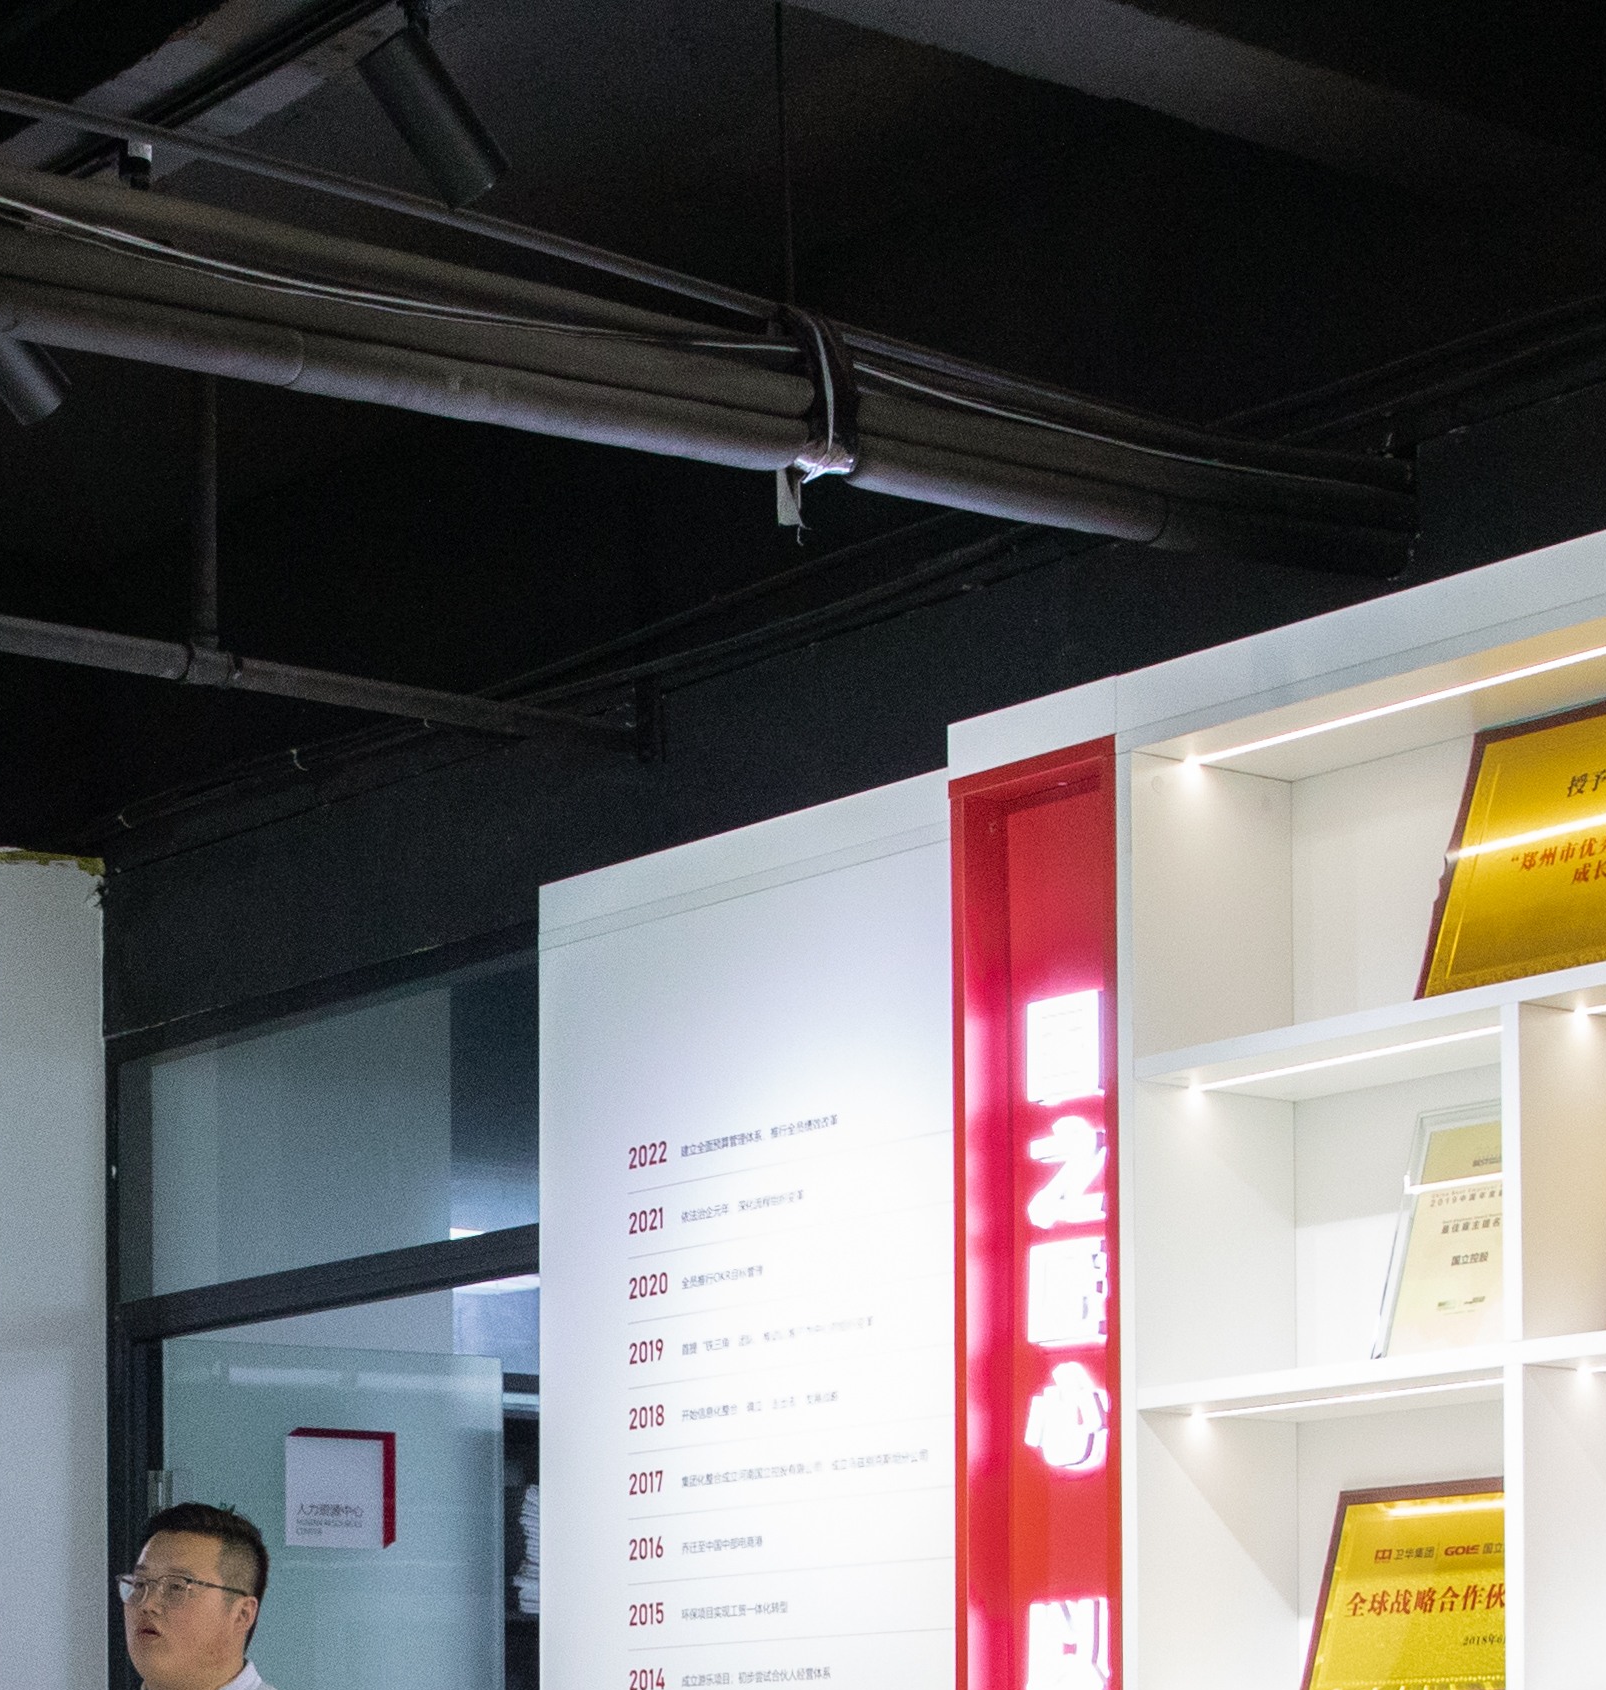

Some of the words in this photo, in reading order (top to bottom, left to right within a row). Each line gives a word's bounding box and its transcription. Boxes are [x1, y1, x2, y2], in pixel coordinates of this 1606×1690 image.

[628, 1140, 668, 1170] 2022
[628, 1206, 665, 1235] 2021
[1450, 1251, 1489, 1266] 国立控股
[628, 1272, 669, 1300] 2020
[628, 1338, 664, 1365] 2019
[628, 1404, 665, 1431] 2018
[628, 1470, 664, 1496] 2017
[628, 1536, 664, 1561] 2016
[628, 1602, 665, 1627] 2015
